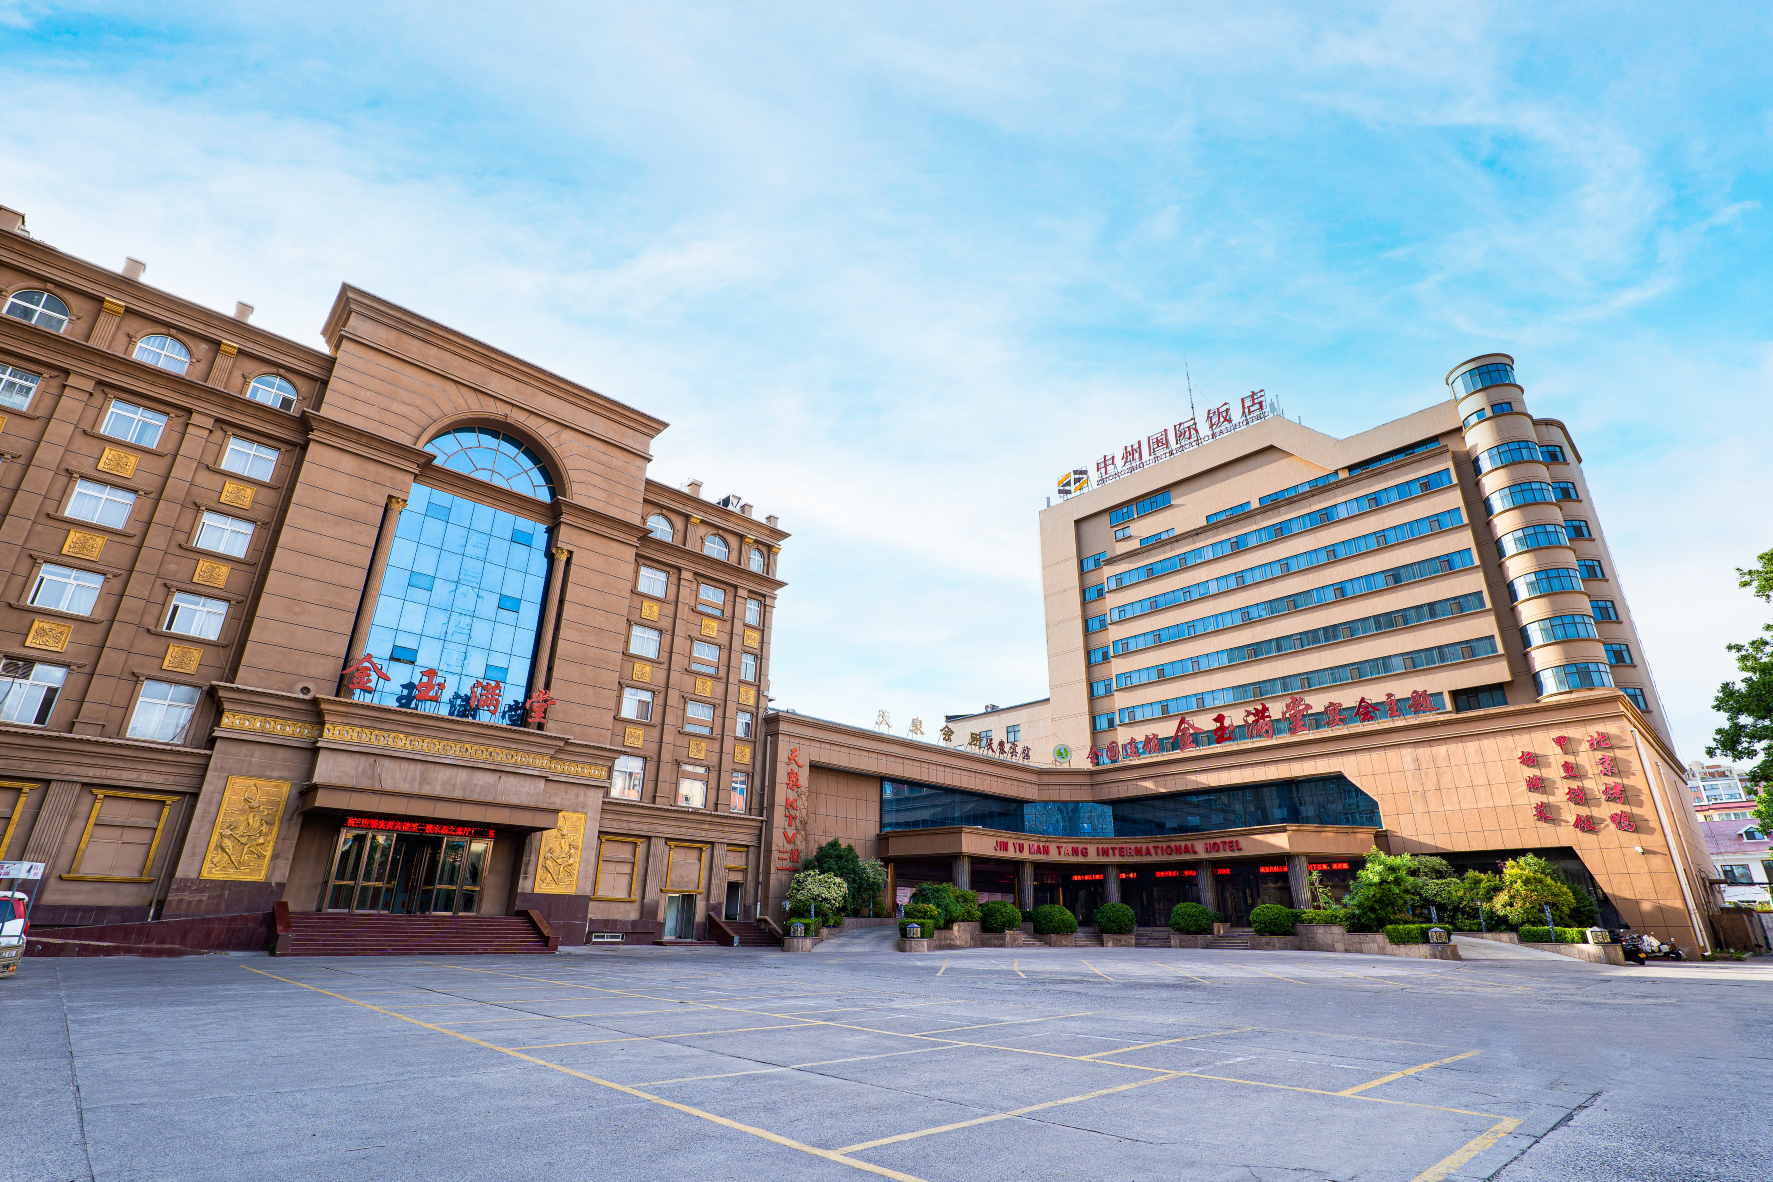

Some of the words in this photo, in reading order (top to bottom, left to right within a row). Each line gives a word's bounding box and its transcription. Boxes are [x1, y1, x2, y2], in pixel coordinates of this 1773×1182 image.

[1096, 389, 1266, 476] 中州国际饭店
[341, 653, 557, 724] 金玉满堂
[876, 709, 983, 749] 天泉会所
[987, 737, 1031, 760] 天泉宾馆
[1518, 750, 1554, 822] 招牌菜
[1552, 735, 1597, 833] 甲鱼捞饭
[1586, 731, 1635, 832] 北京烤鸭
[778, 848, 800, 863] 二楼
[994, 840, 1009, 852] JIN
[1013, 841, 1025, 853] YU
[1029, 843, 1050, 855] MAN
[1057, 845, 1089, 857] TANG
[1096, 843, 1198, 857] INTERNATIONAL
[1203, 839, 1242, 853] HOTEL
